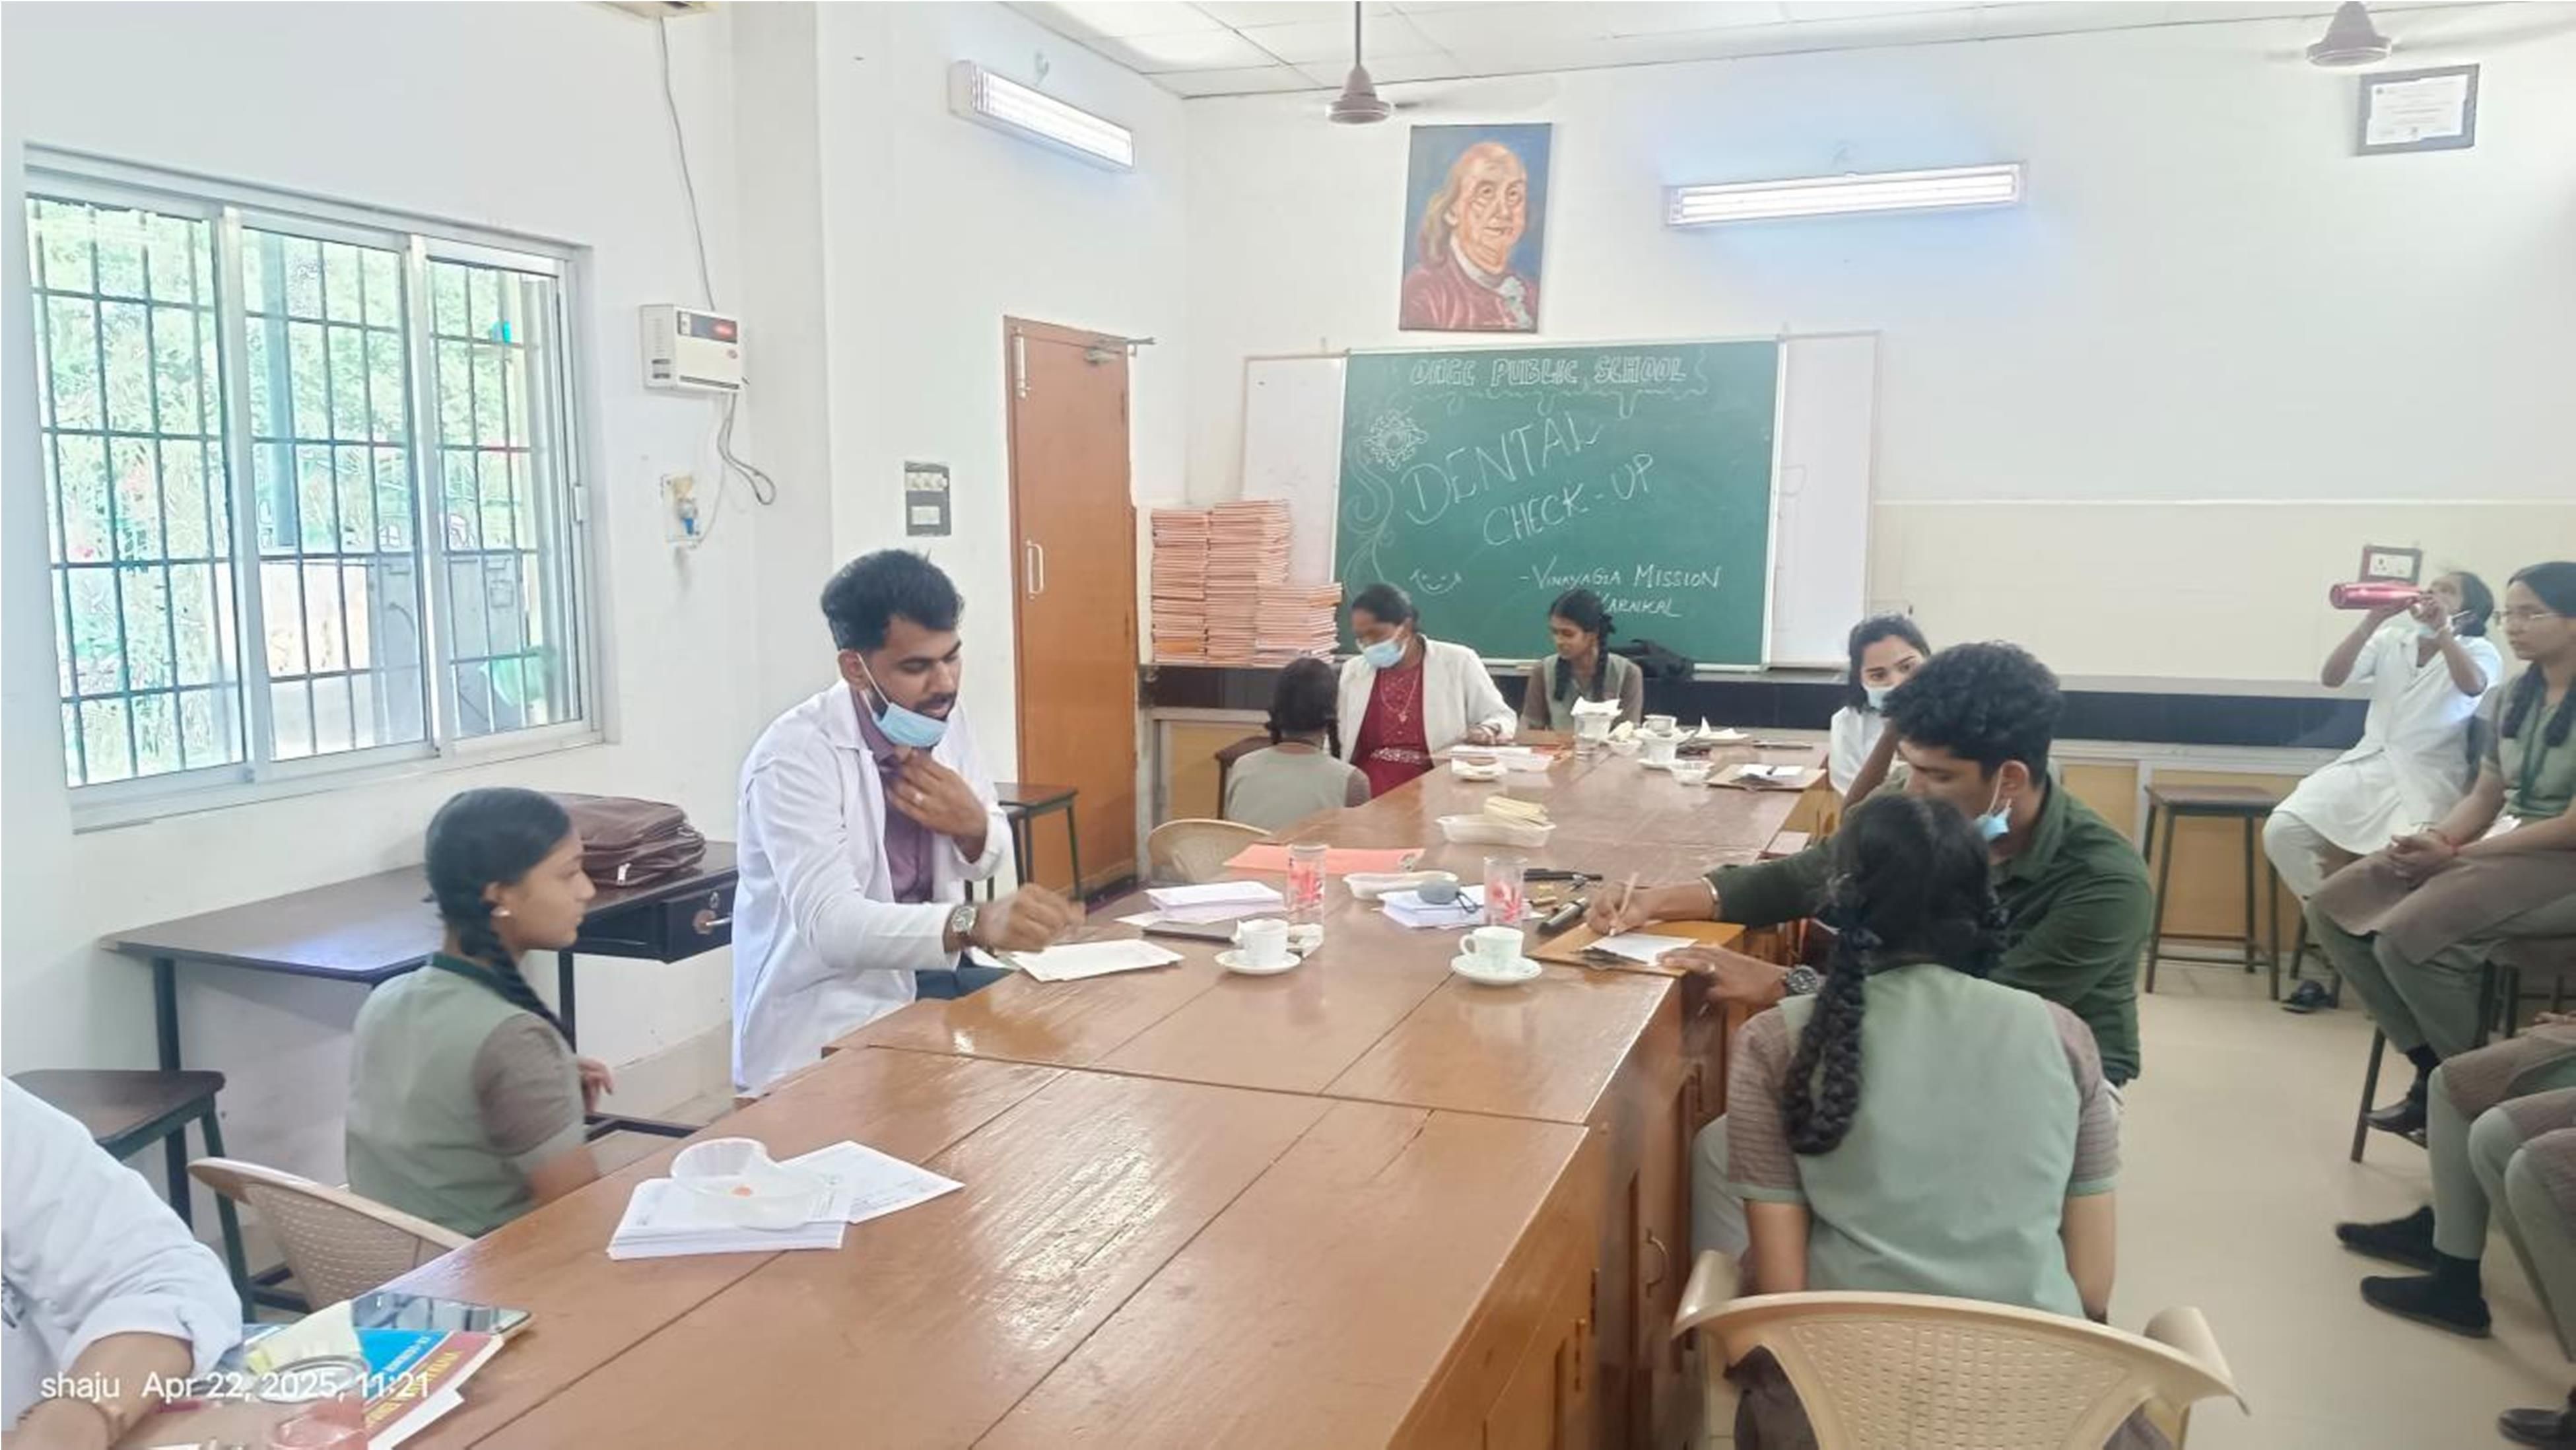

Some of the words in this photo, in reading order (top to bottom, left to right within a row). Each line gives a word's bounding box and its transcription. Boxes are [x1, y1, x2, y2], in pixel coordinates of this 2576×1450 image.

[1491, 359, 1577, 387] PUBLIC
[1594, 355, 1686, 383] SCHOOL
[1401, 411, 1603, 525] DENTAL
[1635, 564, 1720, 588] MISSION
